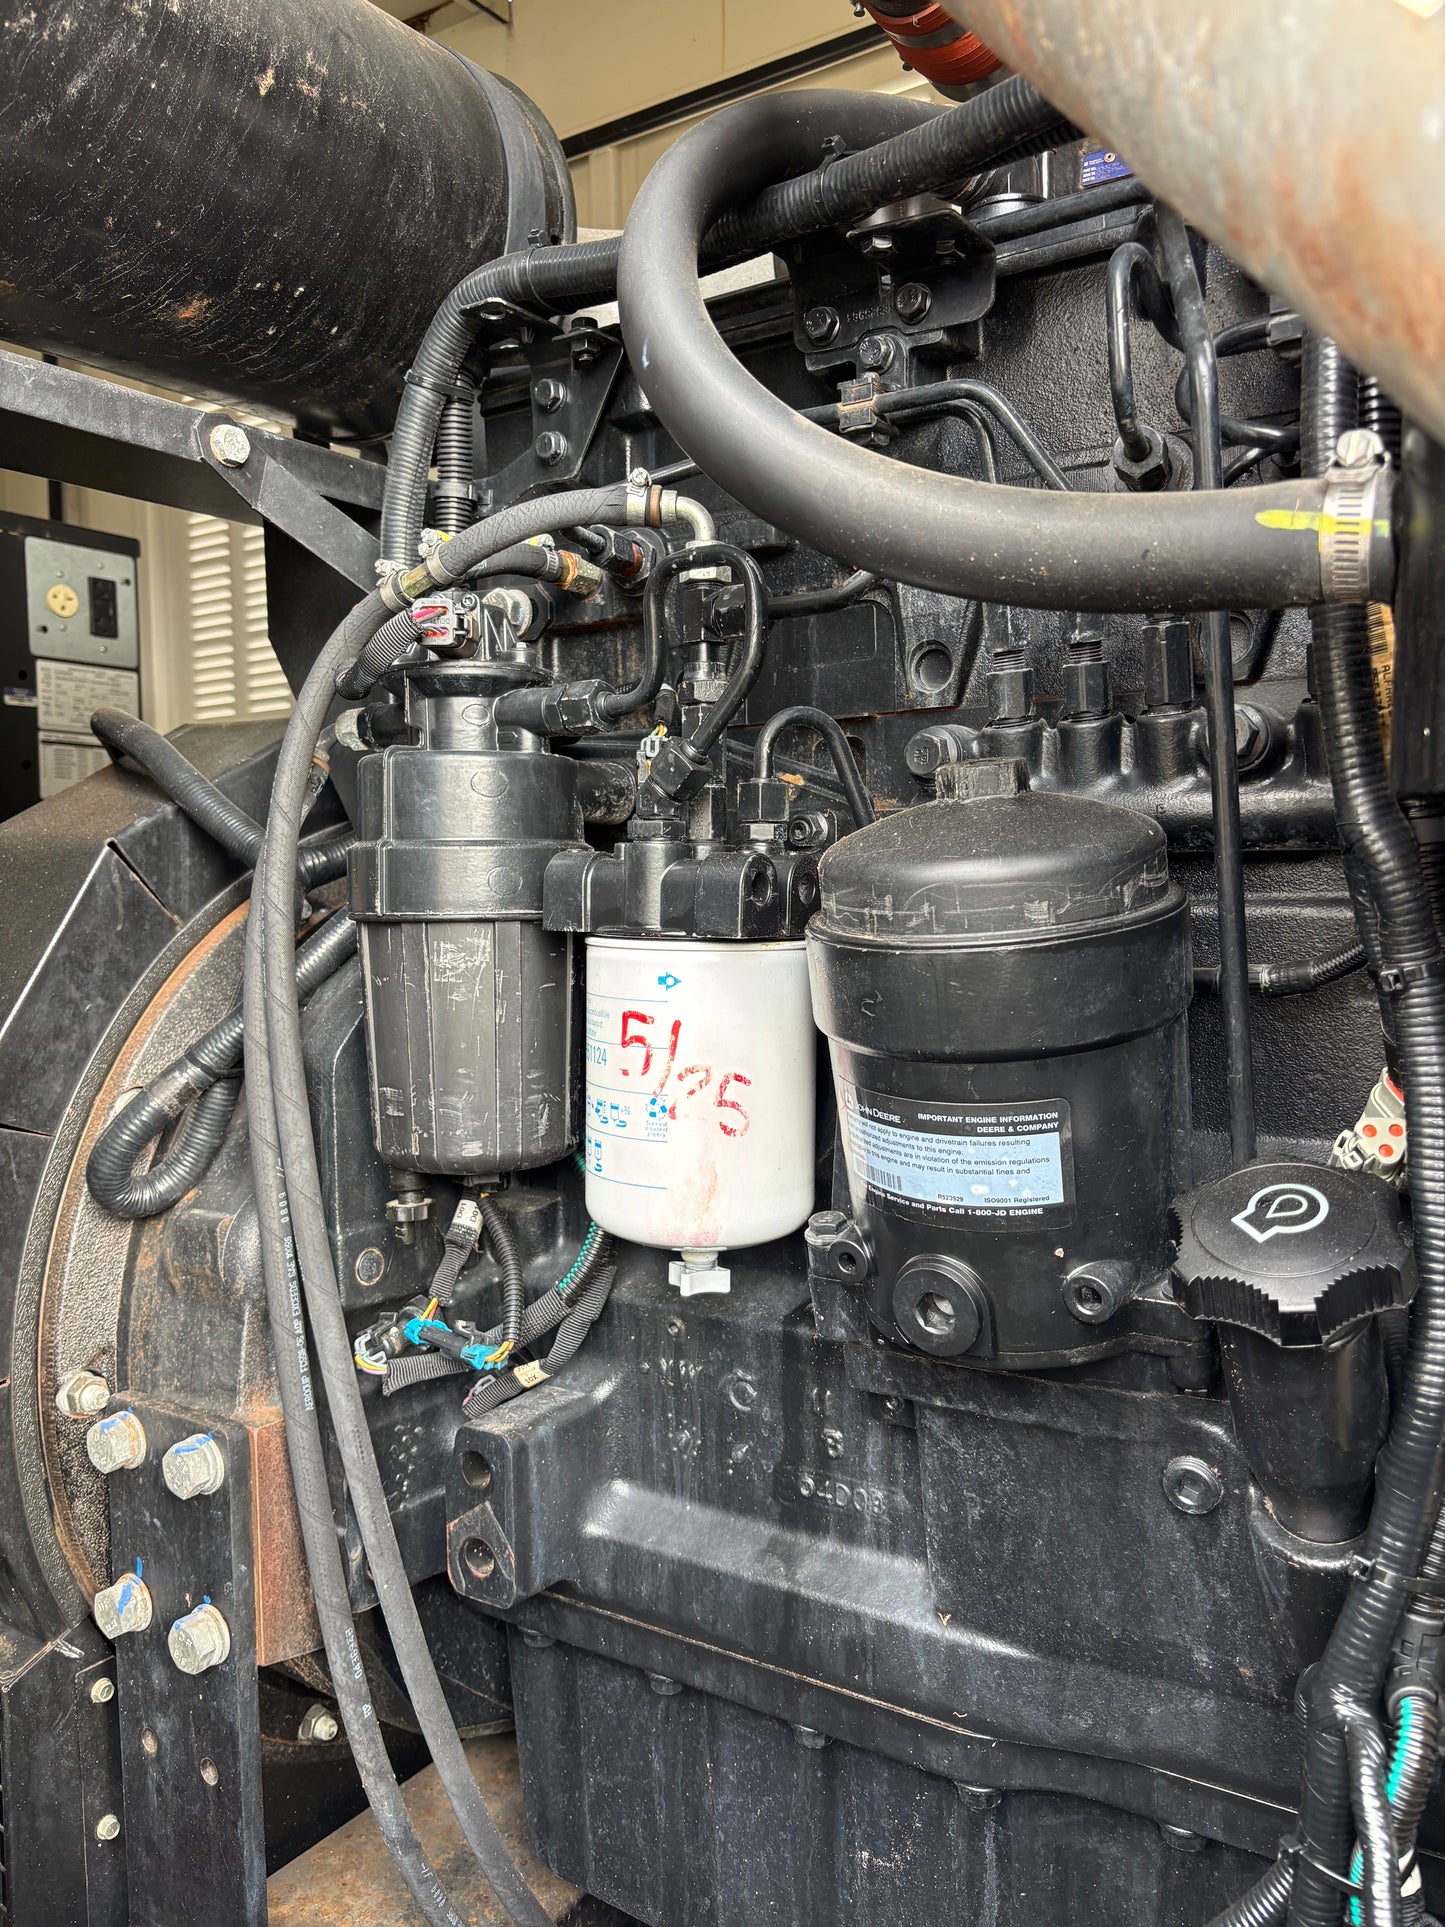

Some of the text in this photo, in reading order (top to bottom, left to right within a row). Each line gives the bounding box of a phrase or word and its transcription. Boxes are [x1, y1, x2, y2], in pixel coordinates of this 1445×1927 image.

[873, 1108, 901, 1123] DEERE
[918, 1113, 963, 1123] IMPORTANT
[1000, 1112, 1058, 1123] INFORMATION
[1016, 1121, 1059, 1132] COMPANY
[882, 1136, 916, 1151] adjustments
[924, 1145, 936, 1153] this
[938, 1147, 964, 1156] engine.
[899, 1132, 919, 1142] engine
[921, 1135, 933, 1143] and
[935, 1137, 967, 1146] drivetrain
[969, 1139, 996, 1147] failures
[998, 1138, 1031, 1147] resulting
[899, 1159, 911, 1168] and
[911, 1163, 925, 1171] may
[926, 1165, 945, 1173] result
[955, 1168, 994, 1176] substantial
[996, 1168, 1014, 1176] fines
[1016, 1167, 1031, 1175] and
[921, 1153, 950, 1164] violation
[951, 1157, 959, 1165] of
[1009, 1156, 1050, 1167] regulations
[277, 1191, 290, 1223] 0809
[886, 1193, 910, 1206] Service
[911, 1201, 925, 1209] and
[926, 1204, 947, 1213] Parts
[949, 1206, 965, 1215] Call
[967, 1208, 1007, 1216] 1-800-JD
[1009, 1207, 1044, 1216] ENGINE
[1013, 1195, 1050, 1204] Registered
[285, 1259, 296, 1278] SAE
[287, 1280, 301, 1316] EXCEEDS
